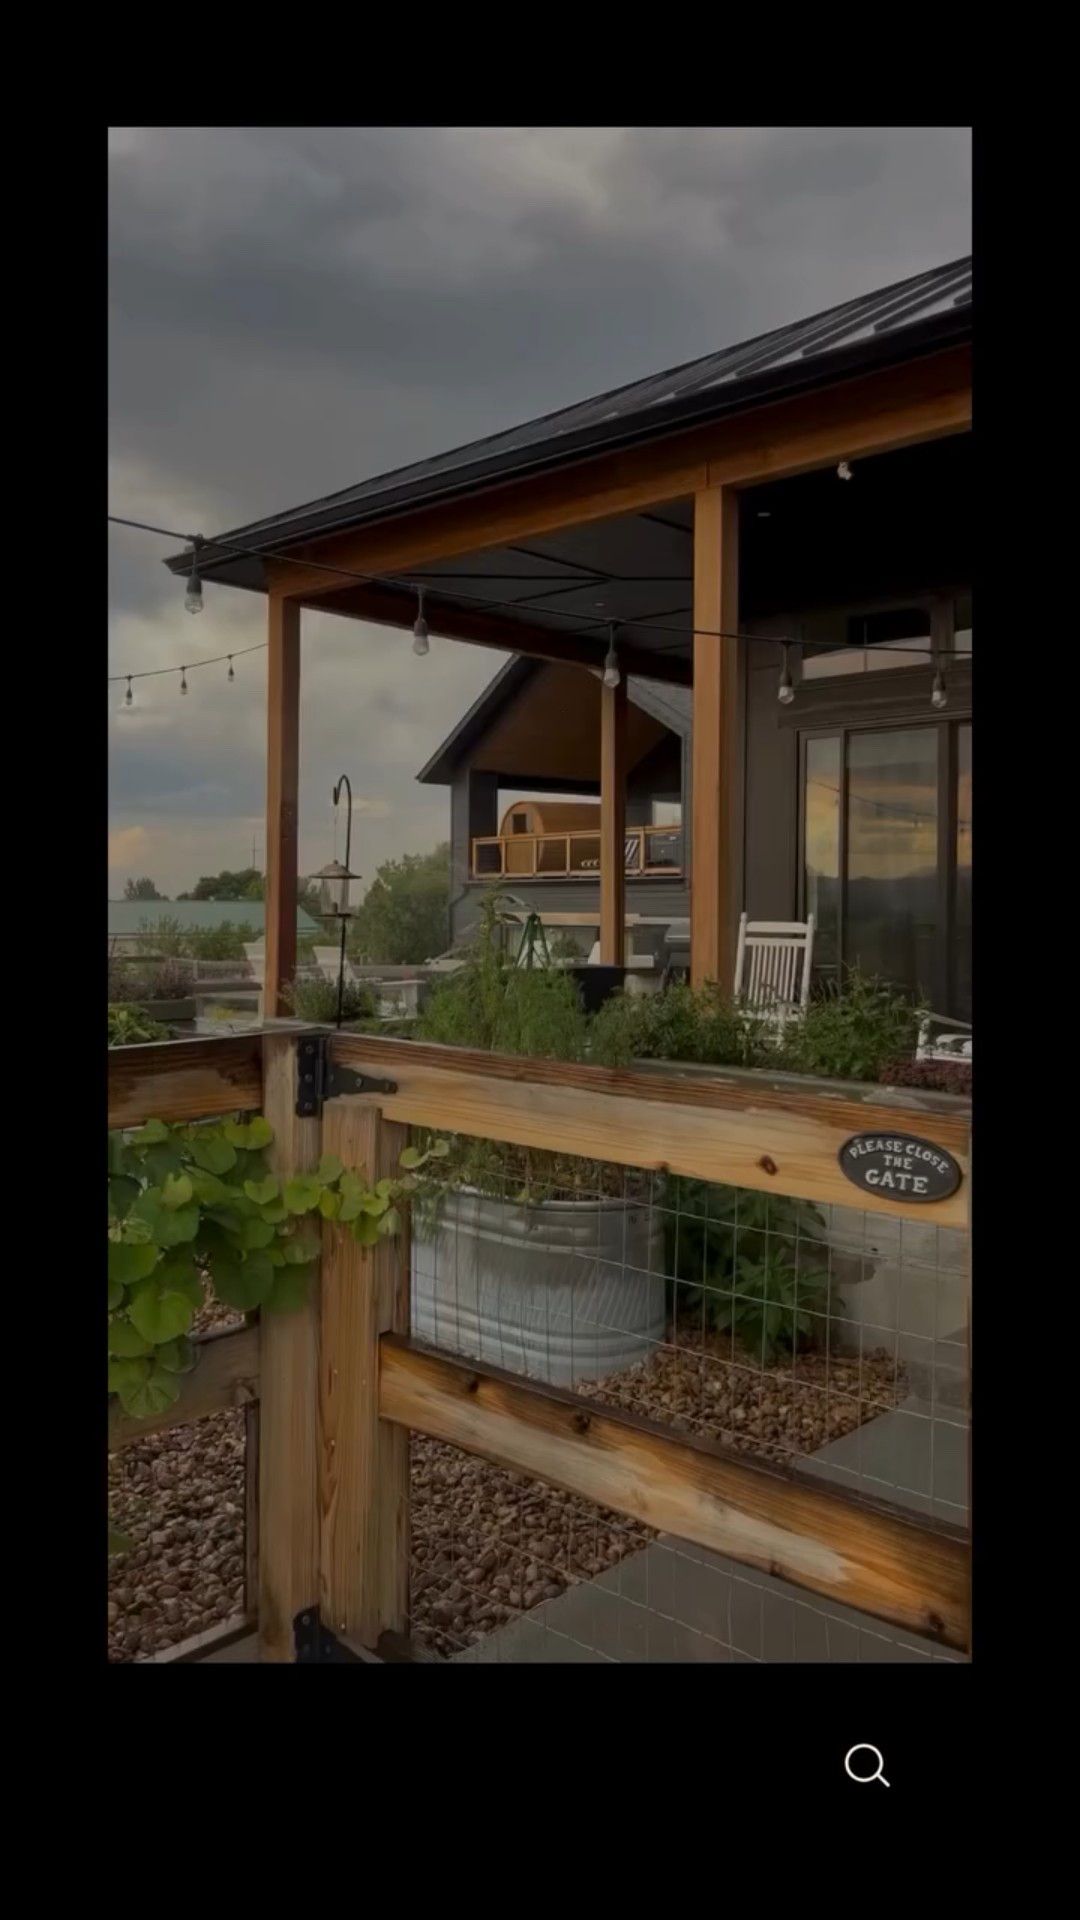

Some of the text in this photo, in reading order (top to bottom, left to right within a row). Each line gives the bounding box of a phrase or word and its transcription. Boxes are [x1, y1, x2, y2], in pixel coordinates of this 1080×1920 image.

[849, 1141, 949, 1173] PLEASE CLOSE
[883, 1154, 913, 1170] THE
[865, 1169, 928, 1194] GATE
